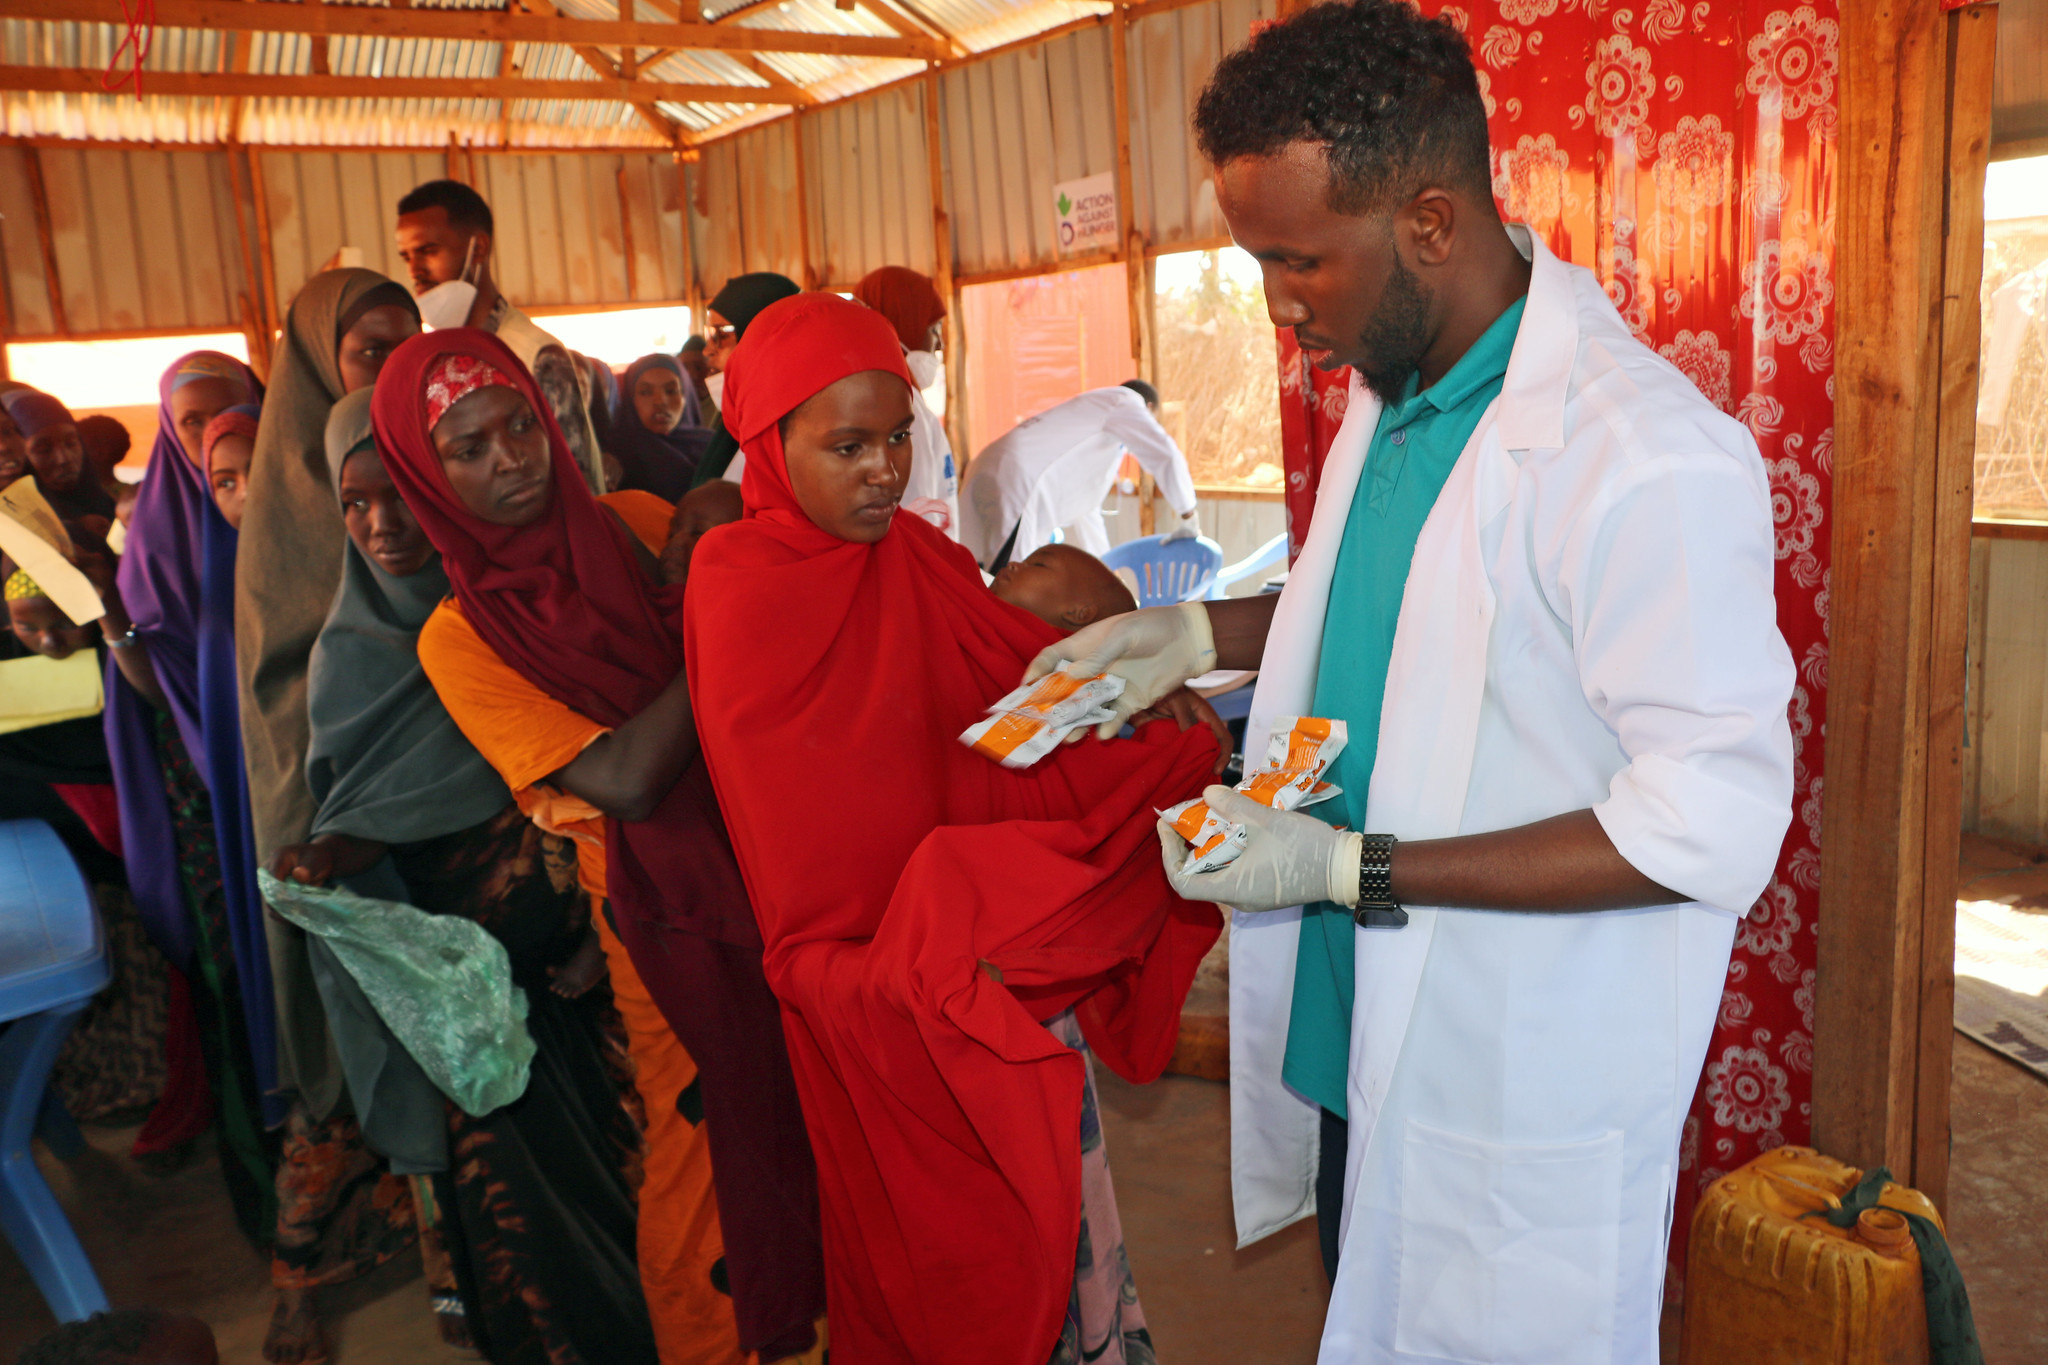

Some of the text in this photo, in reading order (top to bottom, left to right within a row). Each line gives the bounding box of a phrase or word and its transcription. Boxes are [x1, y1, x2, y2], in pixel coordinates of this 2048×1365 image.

[1076, 193, 1113, 211] ACTION
[1077, 207, 1113, 223] AGAINST
[1078, 221, 1115, 237] HUNGER
